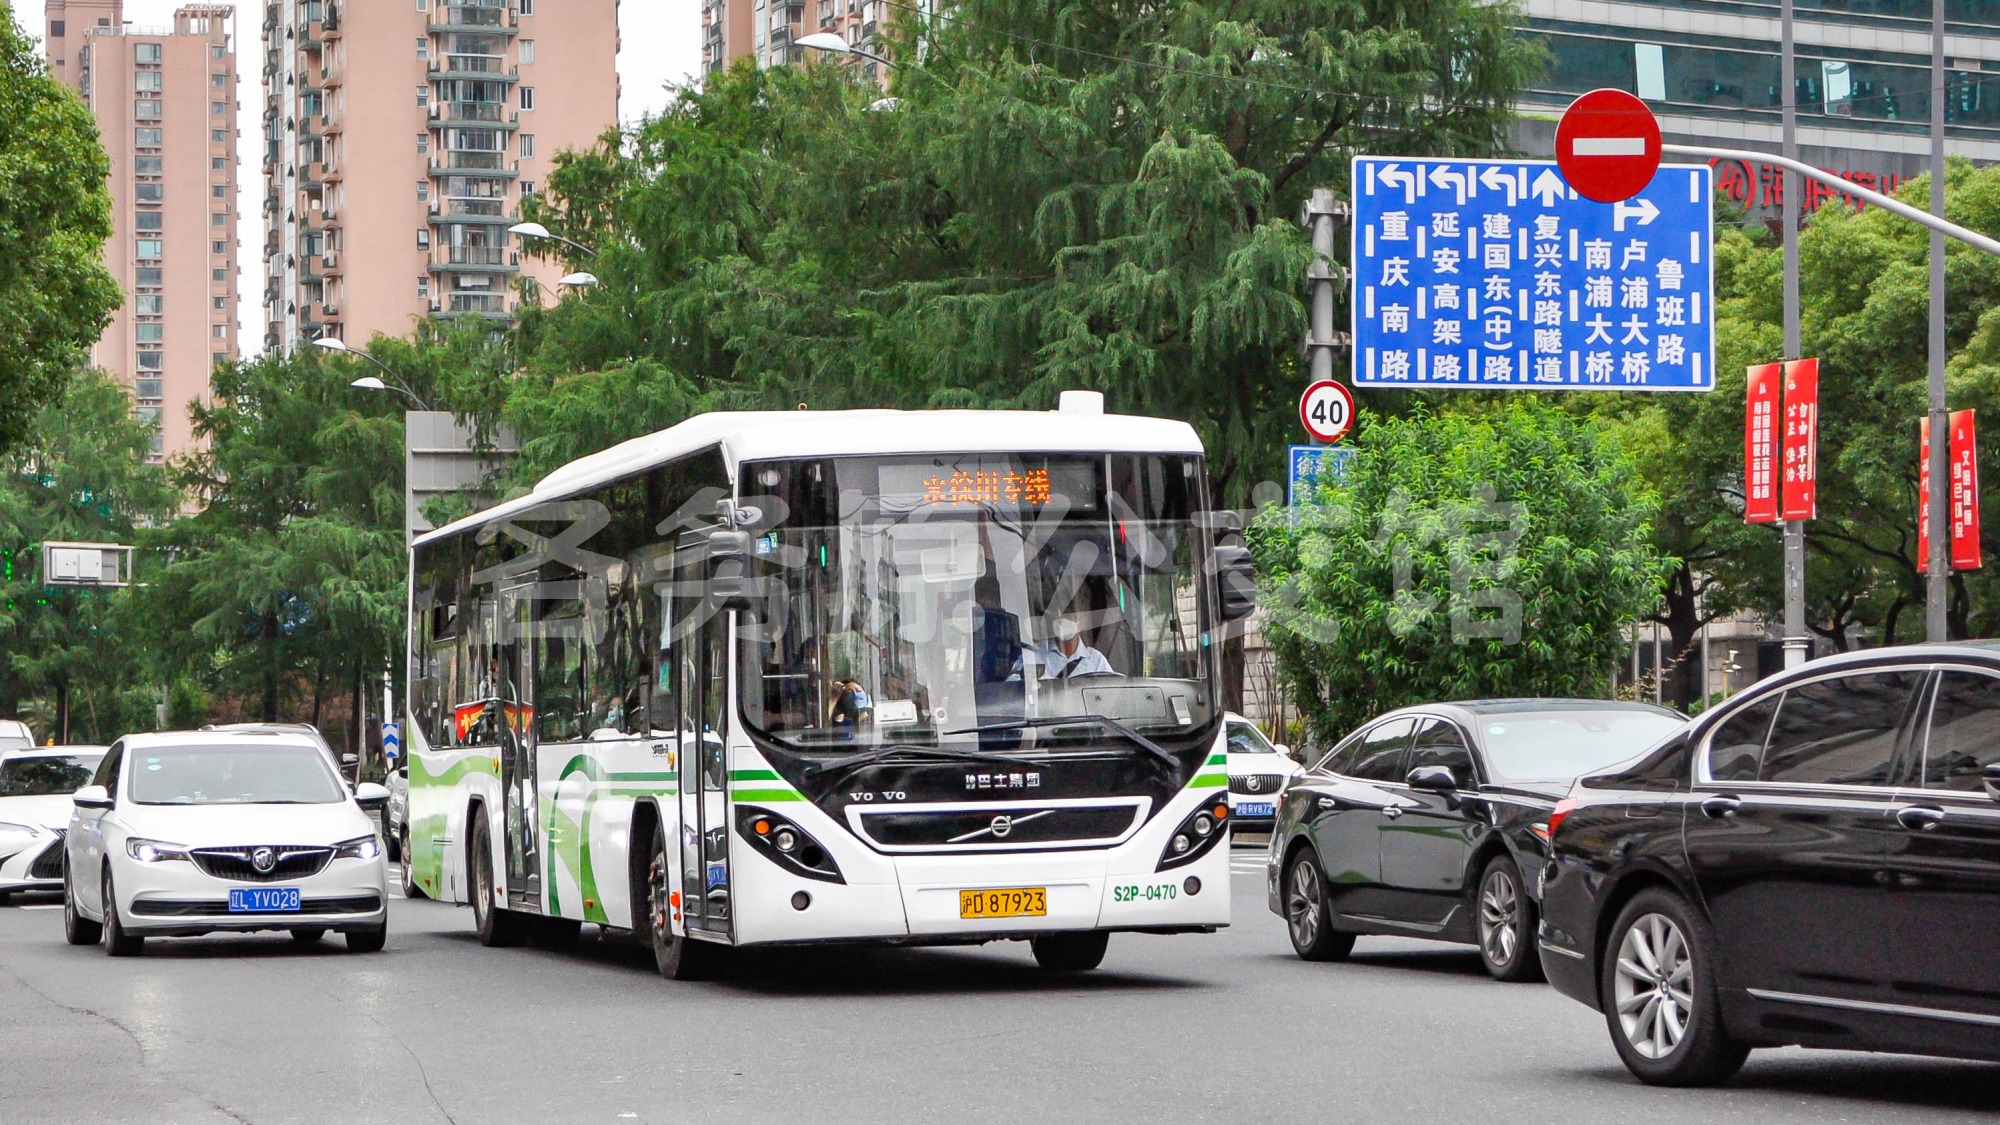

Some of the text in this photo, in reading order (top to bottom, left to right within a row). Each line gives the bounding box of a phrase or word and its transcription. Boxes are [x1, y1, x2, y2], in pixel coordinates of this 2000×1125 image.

[1380, 210, 1411, 381] 重庆南路
[1432, 212, 1462, 382] 延安高架路
[1533, 213, 1563, 383] 复兴东路隧道
[1584, 238, 1615, 383] 南浦大桥
[1620, 239, 1651, 383] 卢浦大桥
[1655, 258, 1686, 366] 鲁班路
[1311, 399, 1343, 425] 40
[1113, 884, 1177, 902] S2P-0470
